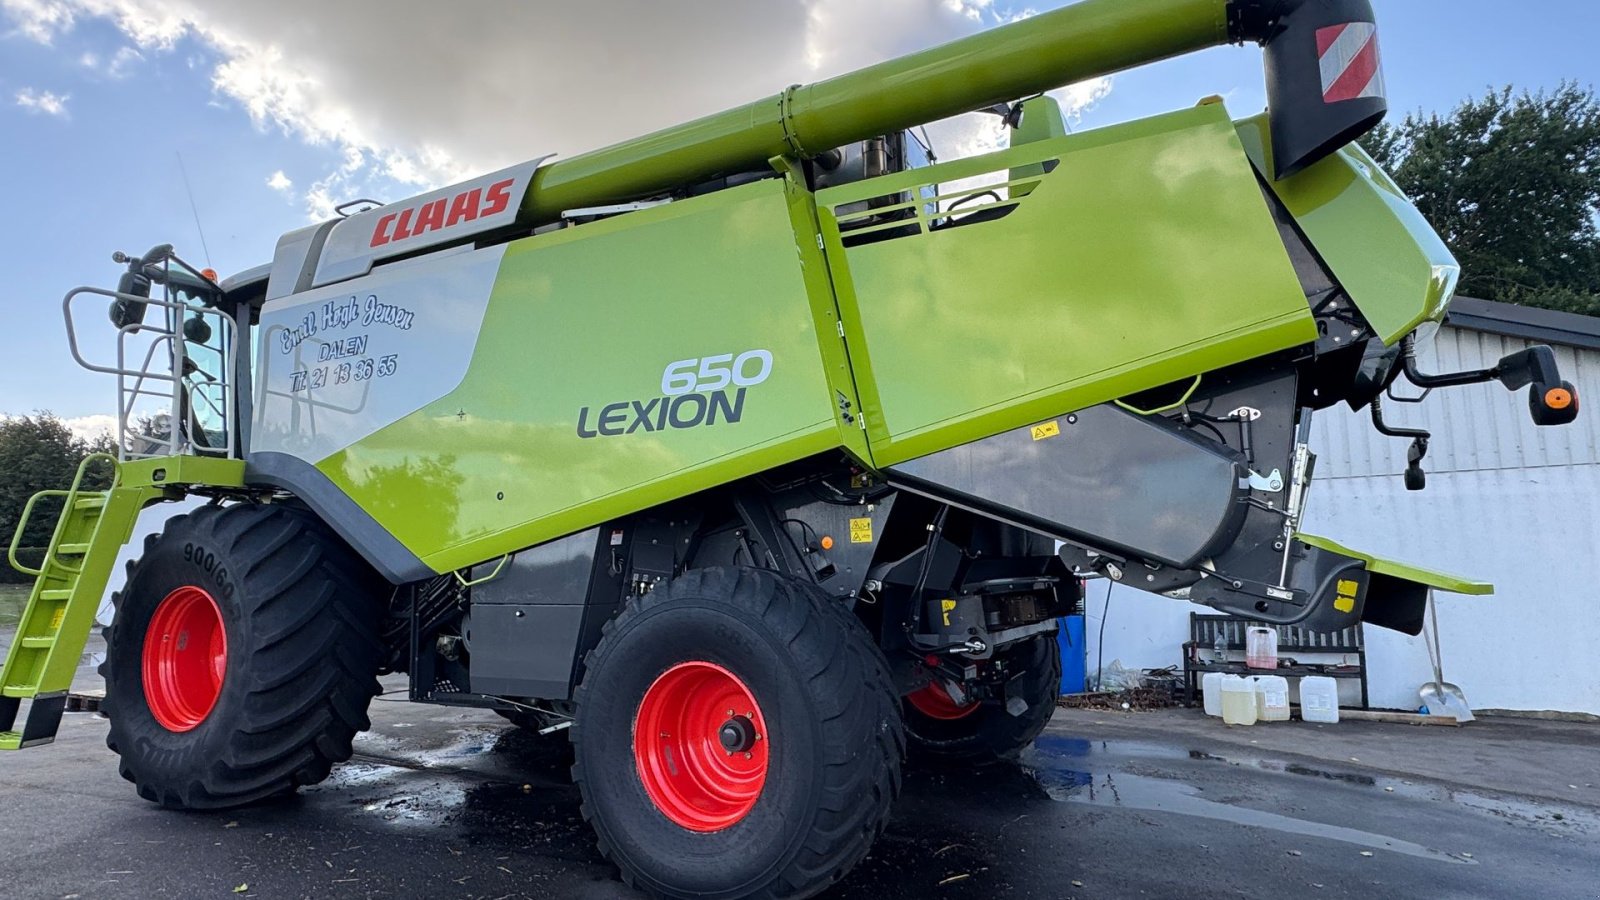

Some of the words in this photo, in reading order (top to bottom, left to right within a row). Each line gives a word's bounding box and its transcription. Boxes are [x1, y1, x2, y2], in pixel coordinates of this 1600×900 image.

[370, 178, 515, 247] CLAAS
[362, 294, 414, 330] Jensen
[318, 334, 368, 362] DALEN
[311, 366, 328, 389] 21
[333, 362, 351, 385] 13
[354, 358, 374, 381] 36
[377, 354, 397, 377] 55
[661, 349, 773, 396] 650
[577, 387, 747, 438] LEXION
